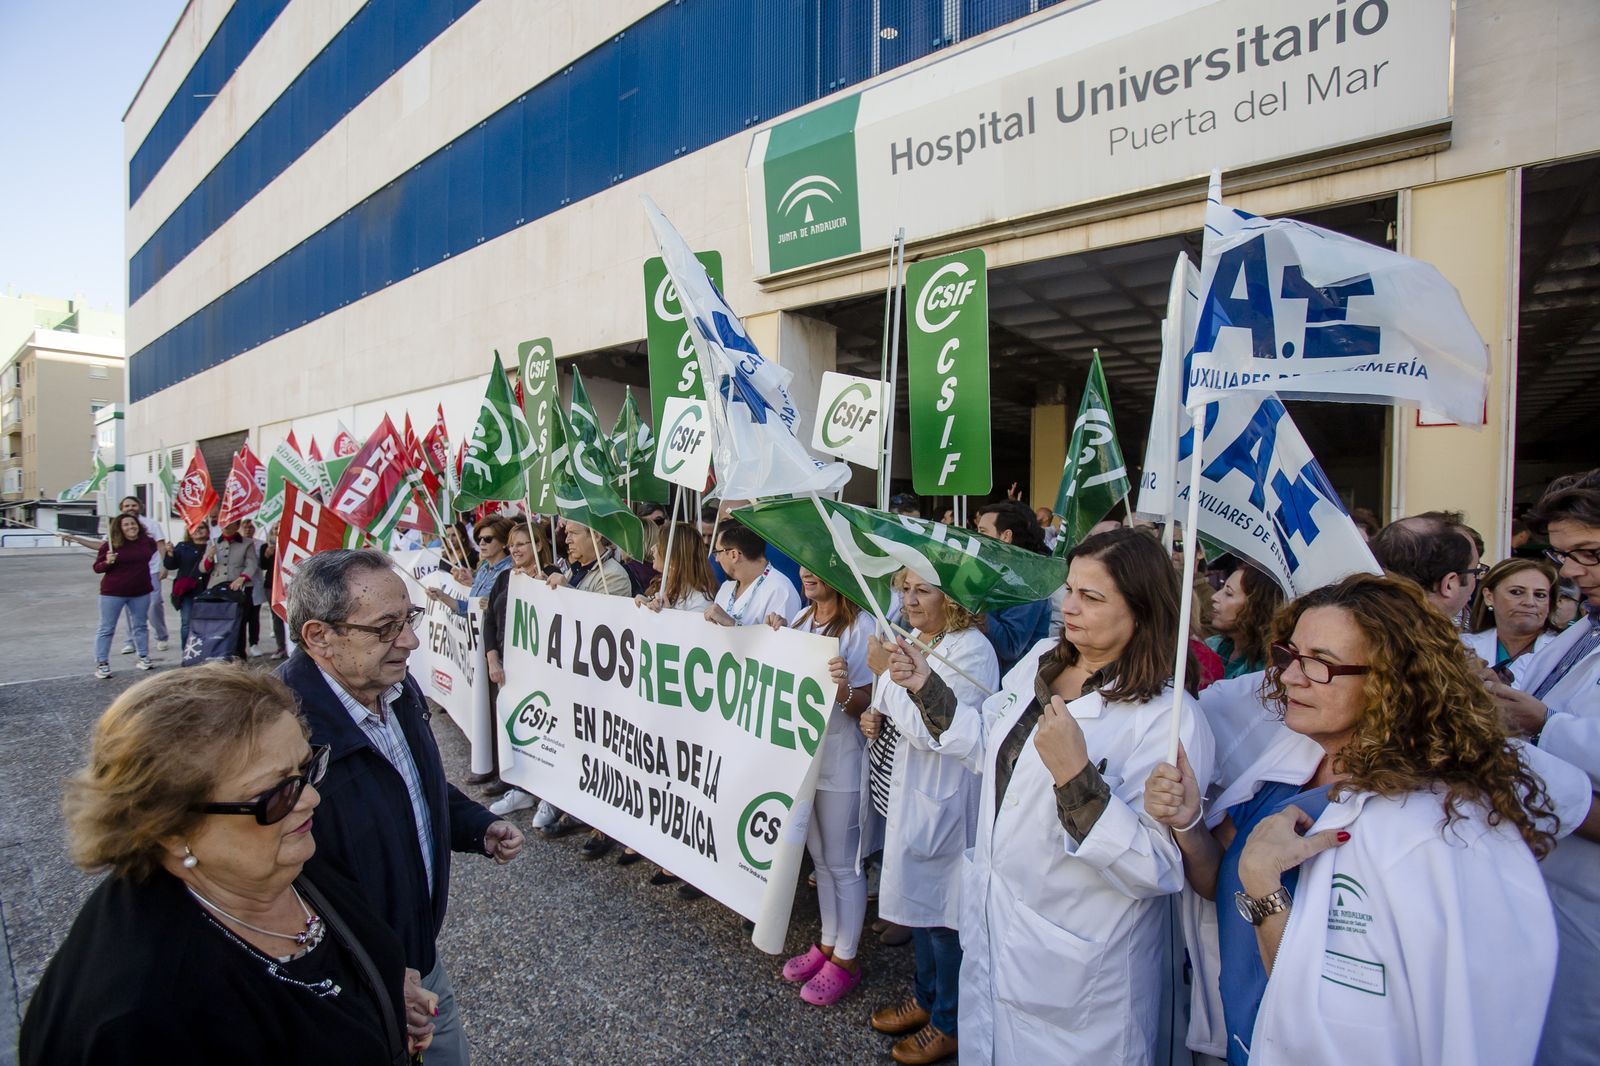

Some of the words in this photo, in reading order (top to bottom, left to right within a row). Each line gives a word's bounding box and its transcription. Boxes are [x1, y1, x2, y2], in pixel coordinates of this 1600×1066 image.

[890, 97, 1036, 176] Hospital
[1055, 0, 1389, 124] Universitario
[1109, 106, 1217, 156] Puerta
[1233, 81, 1287, 123] del
[1307, 60, 1390, 105] Mar
[778, 231, 798, 244] JUNTA
[800, 227, 809, 238] DE
[1252, 523, 1271, 544] DE
[512, 598, 540, 657] NO
[546, 613, 563, 669] A
[572, 620, 635, 689] LOS
[638, 638, 826, 758] RECORTES
[573, 702, 597, 744] EN
[602, 710, 671, 778] DEFENSA
[676, 739, 704, 789] DE
[702, 749, 722, 804] LA
[579, 753, 644, 819] SANIDAD
[648, 781, 718, 863] PÚBLICA
